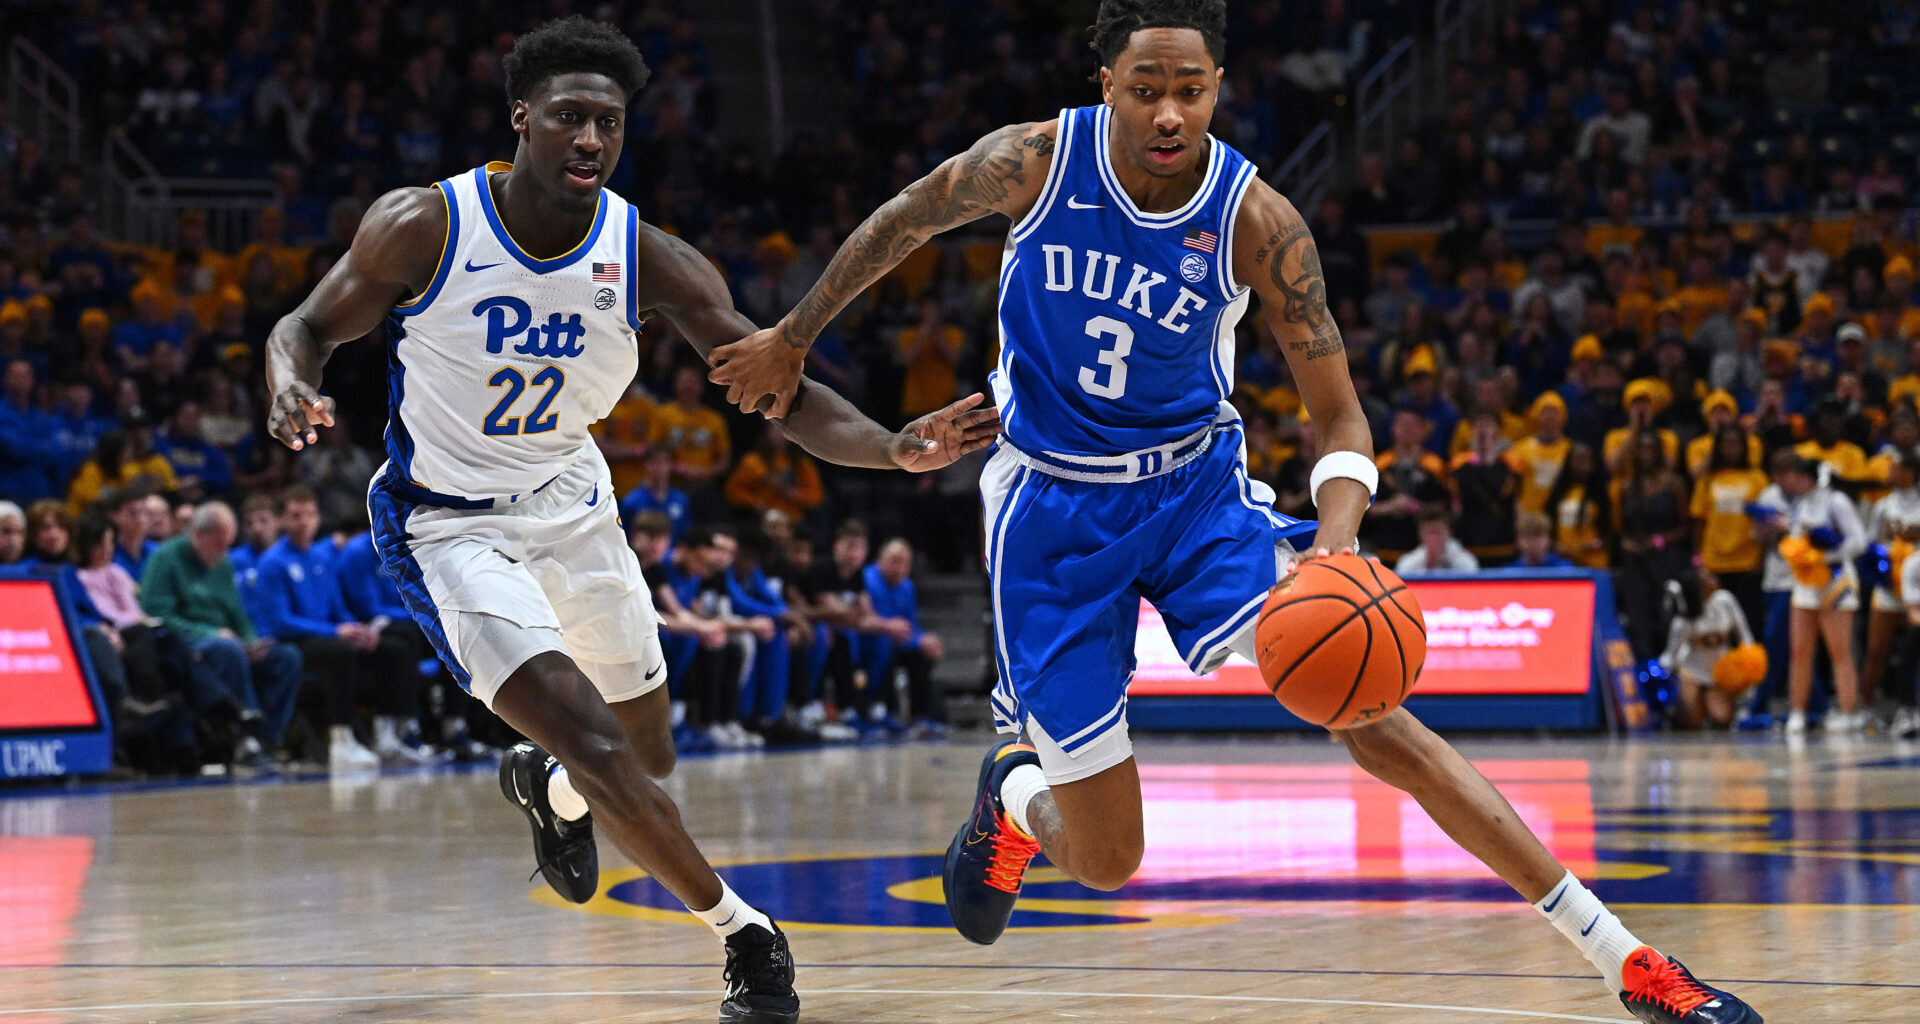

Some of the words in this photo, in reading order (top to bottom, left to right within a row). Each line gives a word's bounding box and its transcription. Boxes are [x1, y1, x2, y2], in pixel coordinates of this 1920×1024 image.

[1042, 244, 1208, 335] DUKE
[472, 295, 586, 359] Pitt
[1077, 315, 1135, 400] 3
[1288, 341, 1310, 351] BUT
[1312, 337, 1331, 349] FOR
[482, 364, 566, 436] 22
[1136, 450, 1163, 477] D
[2, 739, 67, 778] UPMC
